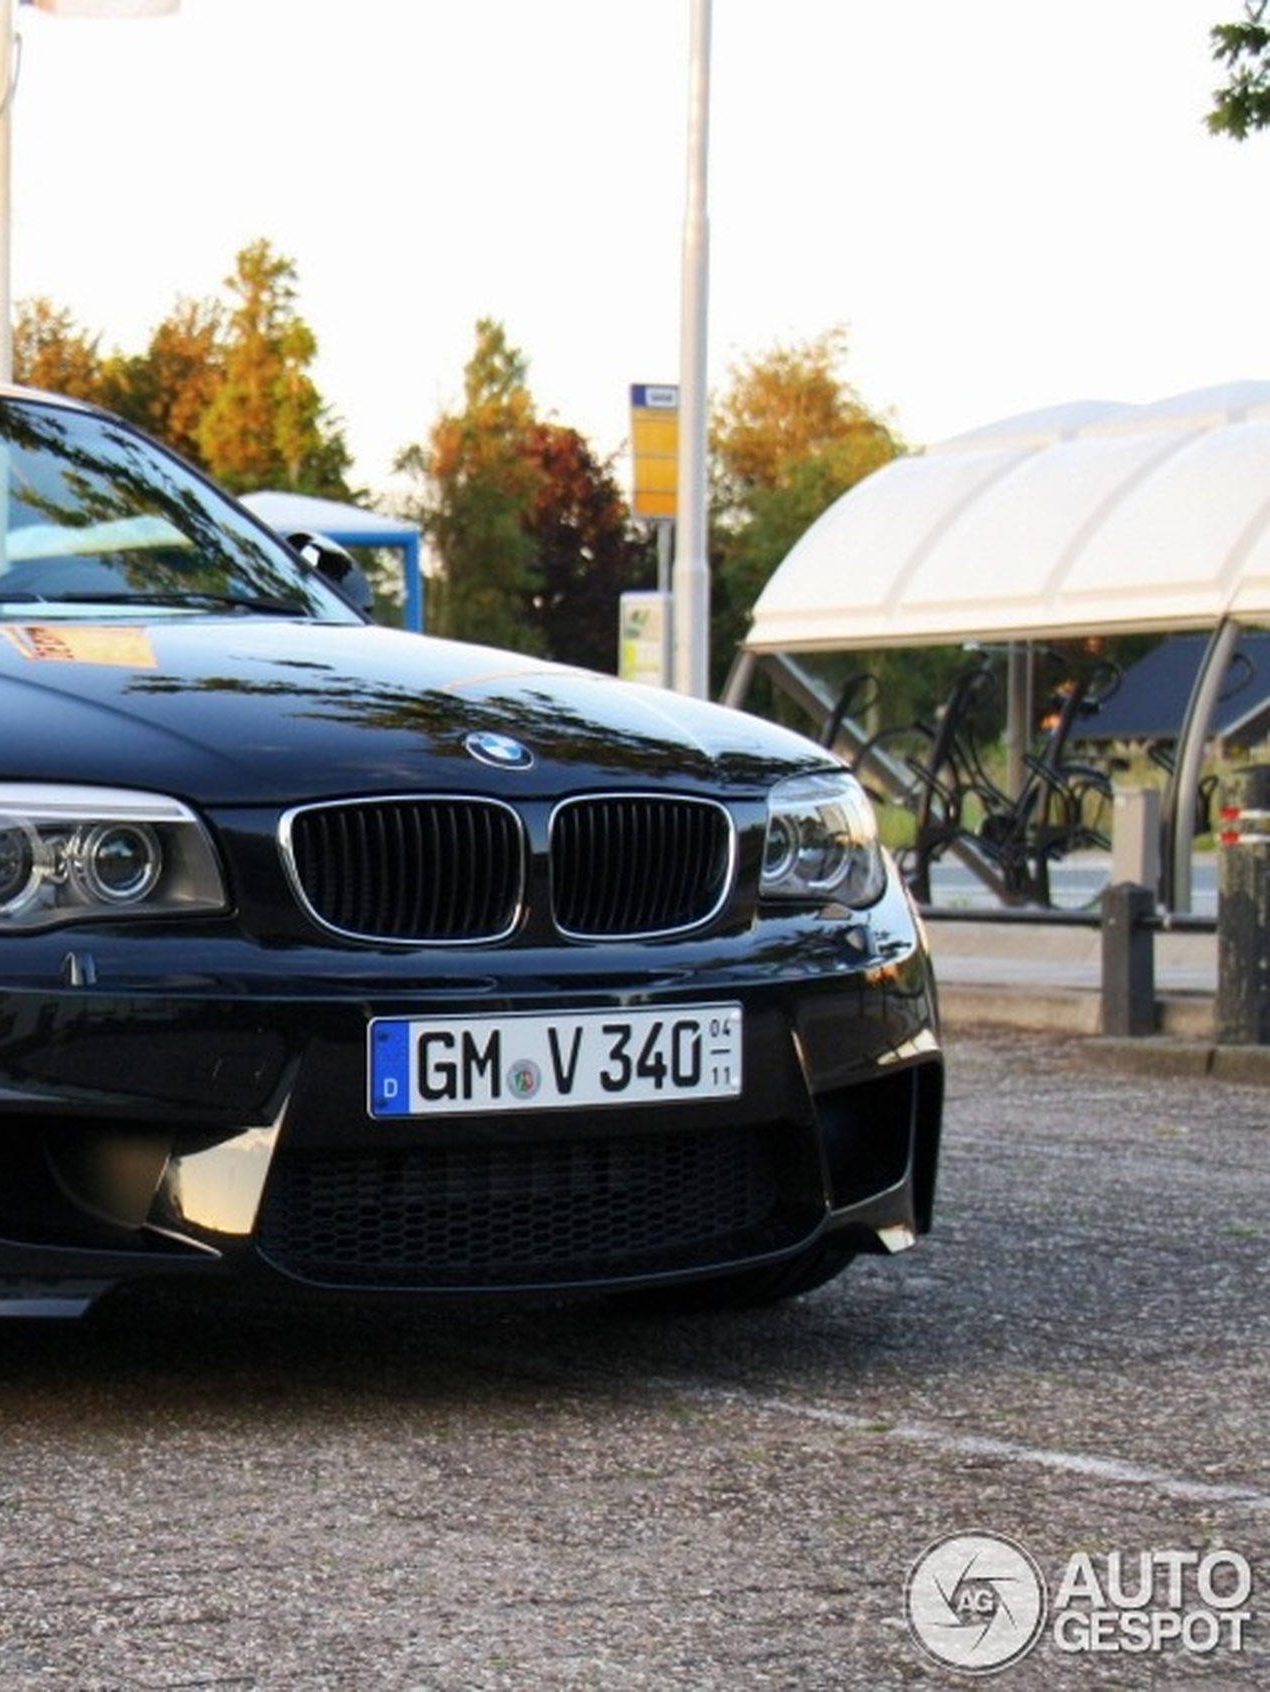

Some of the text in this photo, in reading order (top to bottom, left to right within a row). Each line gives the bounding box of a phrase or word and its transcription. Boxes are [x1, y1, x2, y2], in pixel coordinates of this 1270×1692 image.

[709, 1018, 731, 1038] 04
[418, 1020, 702, 1101] GM V 340
[711, 1066, 731, 1086] 11
[383, 1077, 398, 1098] D
